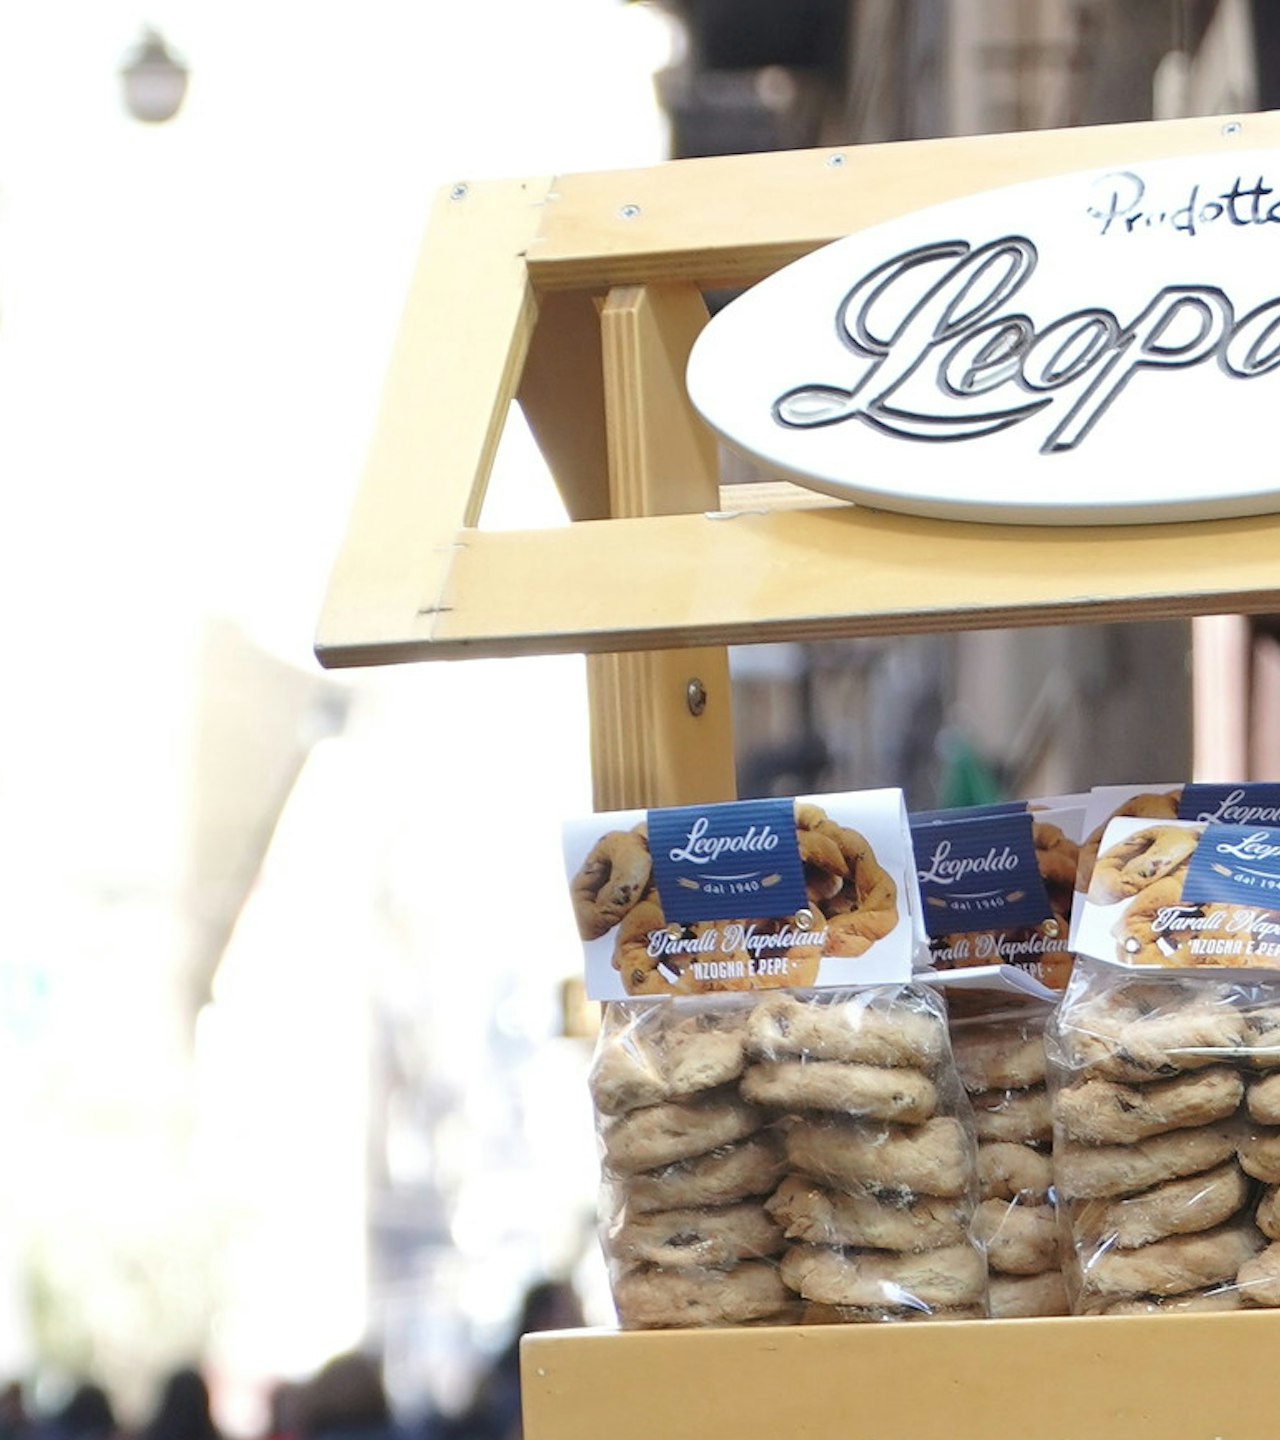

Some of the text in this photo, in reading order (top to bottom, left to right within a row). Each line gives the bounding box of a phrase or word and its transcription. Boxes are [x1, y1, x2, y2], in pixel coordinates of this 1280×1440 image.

[668, 817, 779, 864] Leopoldo
[918, 841, 1019, 884] Leopoldo
[703, 879, 760, 894] dal 1940
[1234, 874, 1255, 887] dal
[1151, 906, 1223, 937] Taralli
[646, 921, 828, 958] Taralli Napoletani
[975, 933, 1069, 962] Napoletan
[1247, 942, 1256, 957] E
[747, 959, 757, 977] E
[757, 957, 789, 976] PEPE
